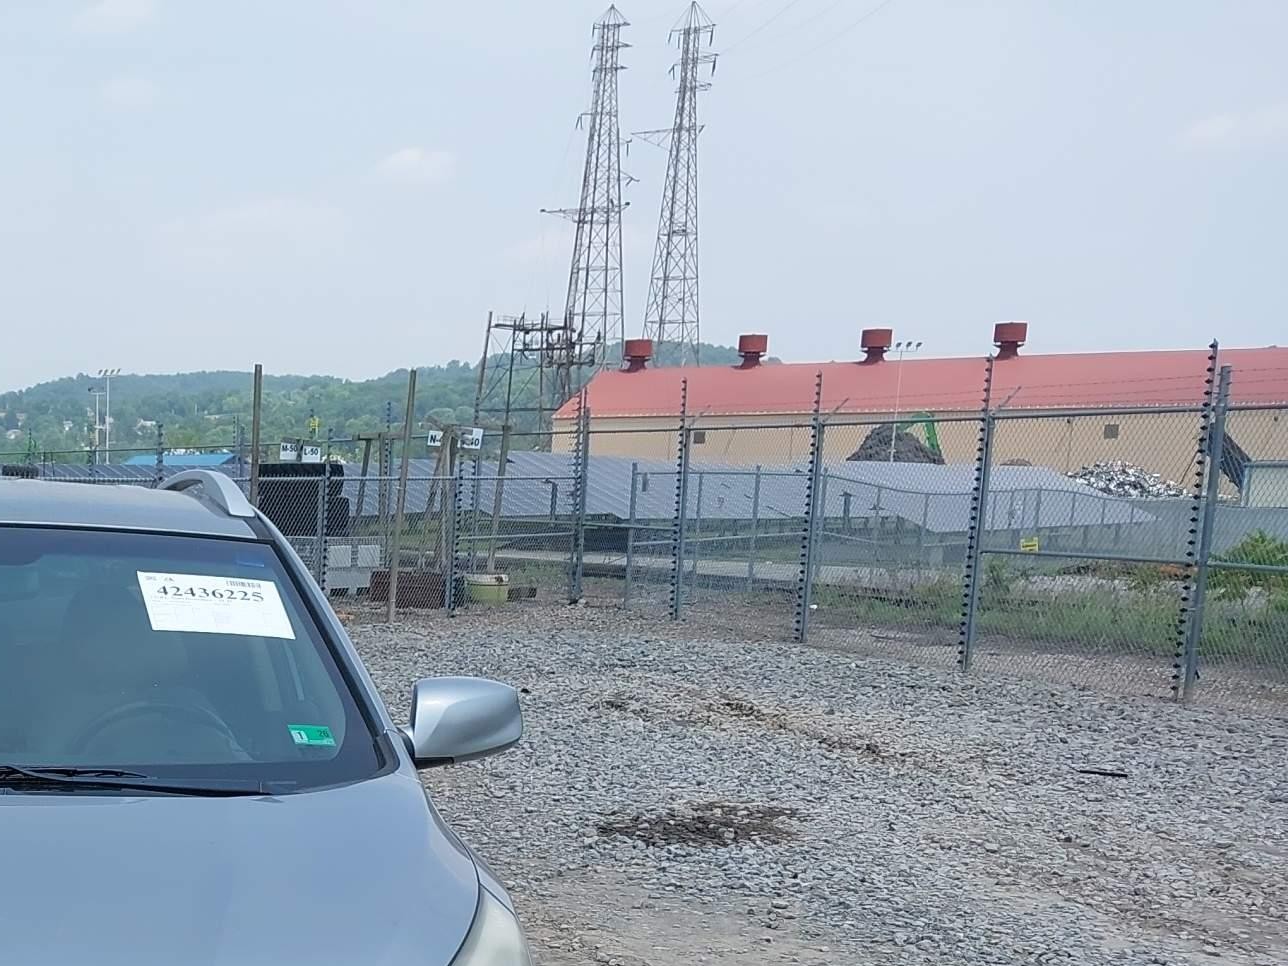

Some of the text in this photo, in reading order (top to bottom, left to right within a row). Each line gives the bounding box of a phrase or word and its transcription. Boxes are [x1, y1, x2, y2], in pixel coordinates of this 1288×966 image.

[281, 444, 298, 453] M-50
[303, 447, 319, 456] L-50
[156, 585, 265, 603] 42436225
